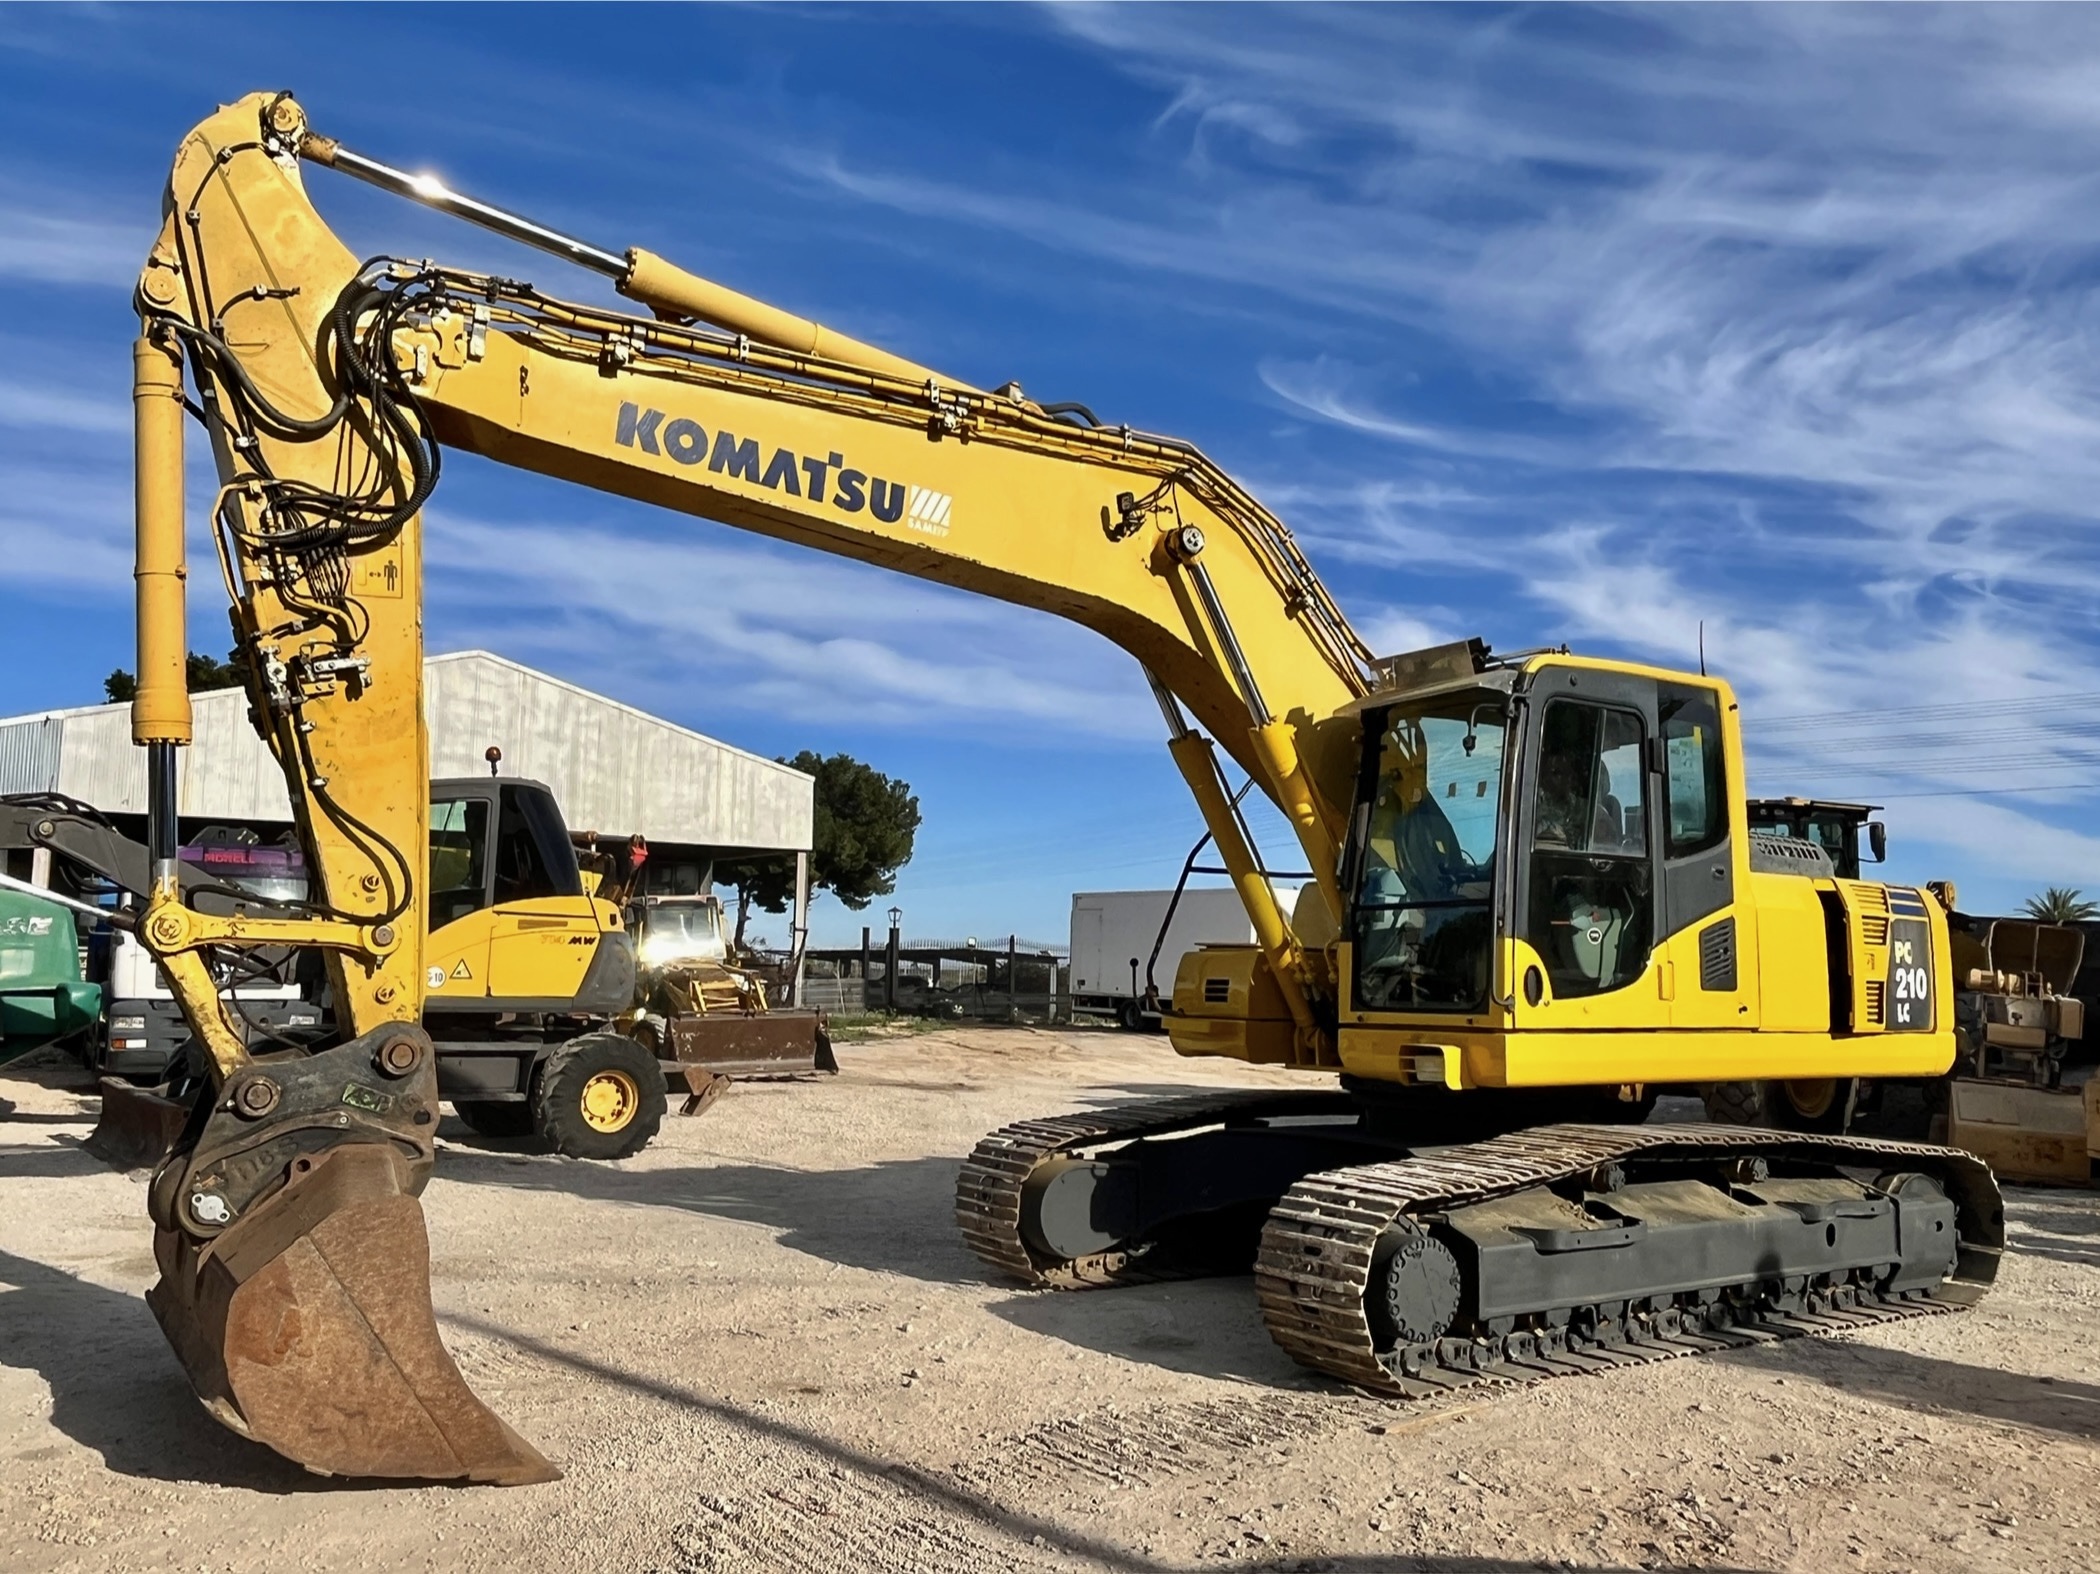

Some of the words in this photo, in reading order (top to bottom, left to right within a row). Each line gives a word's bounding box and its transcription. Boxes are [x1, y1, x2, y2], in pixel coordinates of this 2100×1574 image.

[615, 400, 906, 523] KOMATSU
[1894, 940, 1913, 965] PC
[1895, 967, 1928, 1000] 210
[1897, 1002, 1911, 1024] LC
